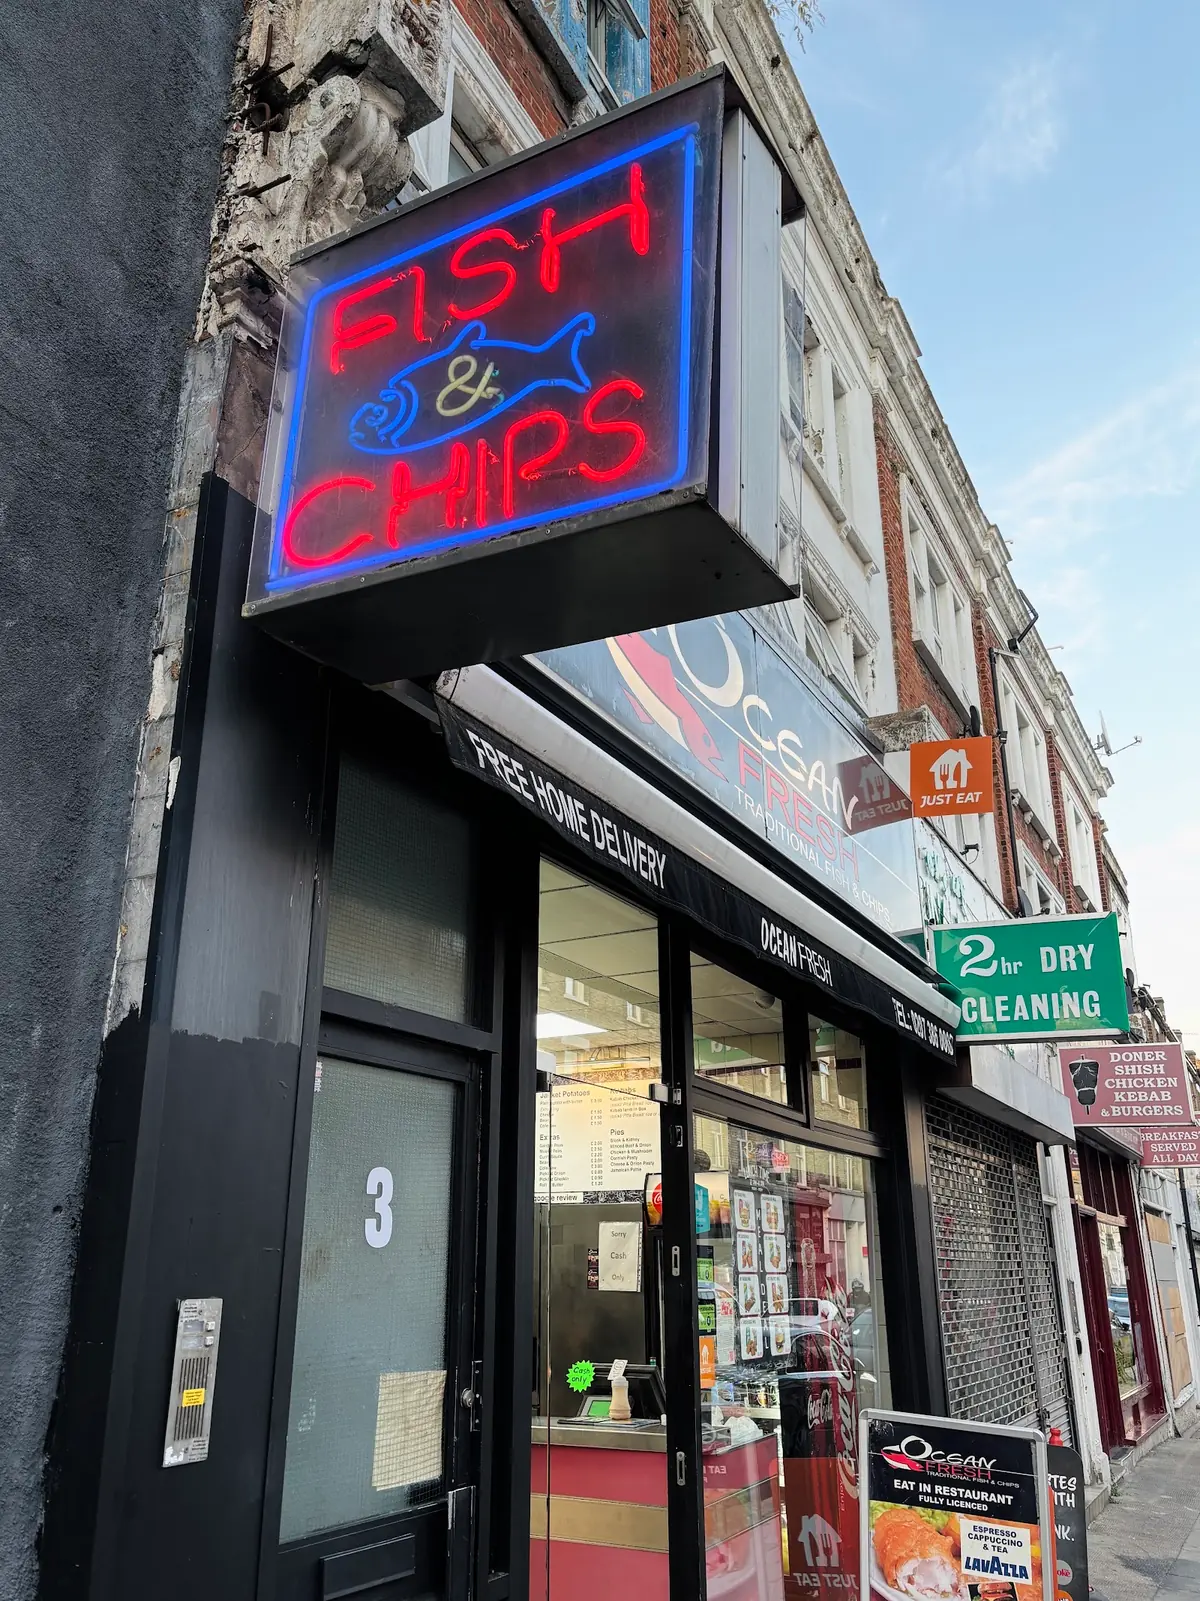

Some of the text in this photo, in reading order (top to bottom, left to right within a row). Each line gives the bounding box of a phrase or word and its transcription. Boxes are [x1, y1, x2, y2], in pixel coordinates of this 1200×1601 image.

[330, 162, 649, 375] FISH
[436, 354, 503, 417] &
[284, 379, 647, 568] CHIPS
[919, 791, 983, 808] JUST EAT
[466, 728, 666, 889] FREE HOME DELIVERY
[738, 738, 860, 882] FRESH
[734, 785, 891, 922] TRADITIONAL FISH & CHIPS
[761, 917, 833, 987] OCEAN FRESH
[1040, 943, 1095, 974] DRY
[961, 990, 1101, 1023] CLEANING
[1109, 1051, 1167, 1063] DONER
[1114, 1064, 1165, 1075] SHISH
[1104, 1077, 1178, 1089] CHICKEN
[1114, 1091, 1171, 1102] KEBAB
[1151, 1142, 1196, 1152] SERVED
[1152, 1153, 1199, 1163] ALL DAY
[364, 1166, 394, 1249] 3
[611, 1230, 627, 1239] Sorry
[610, 1251, 627, 1259] Cash
[611, 1273, 625, 1282] Only
[573, 1366, 591, 1374] Cash
[571, 1374, 587, 1384] only
[900, 1435, 997, 1470] OCEAN
[925, 1461, 991, 1480] FRESH
[926, 1470, 971, 1482] TRADITIONAL
[997, 1480, 1019, 1488] CHIPS
[894, 1479, 1013, 1506] EAT IN RESTAURANT
[918, 1494, 988, 1512] FULLY LICENCED
[972, 1525, 1017, 1538] ESPRESSO
[967, 1533, 1023, 1548] CAPPUCCINO
[982, 1543, 1008, 1554] & TEA
